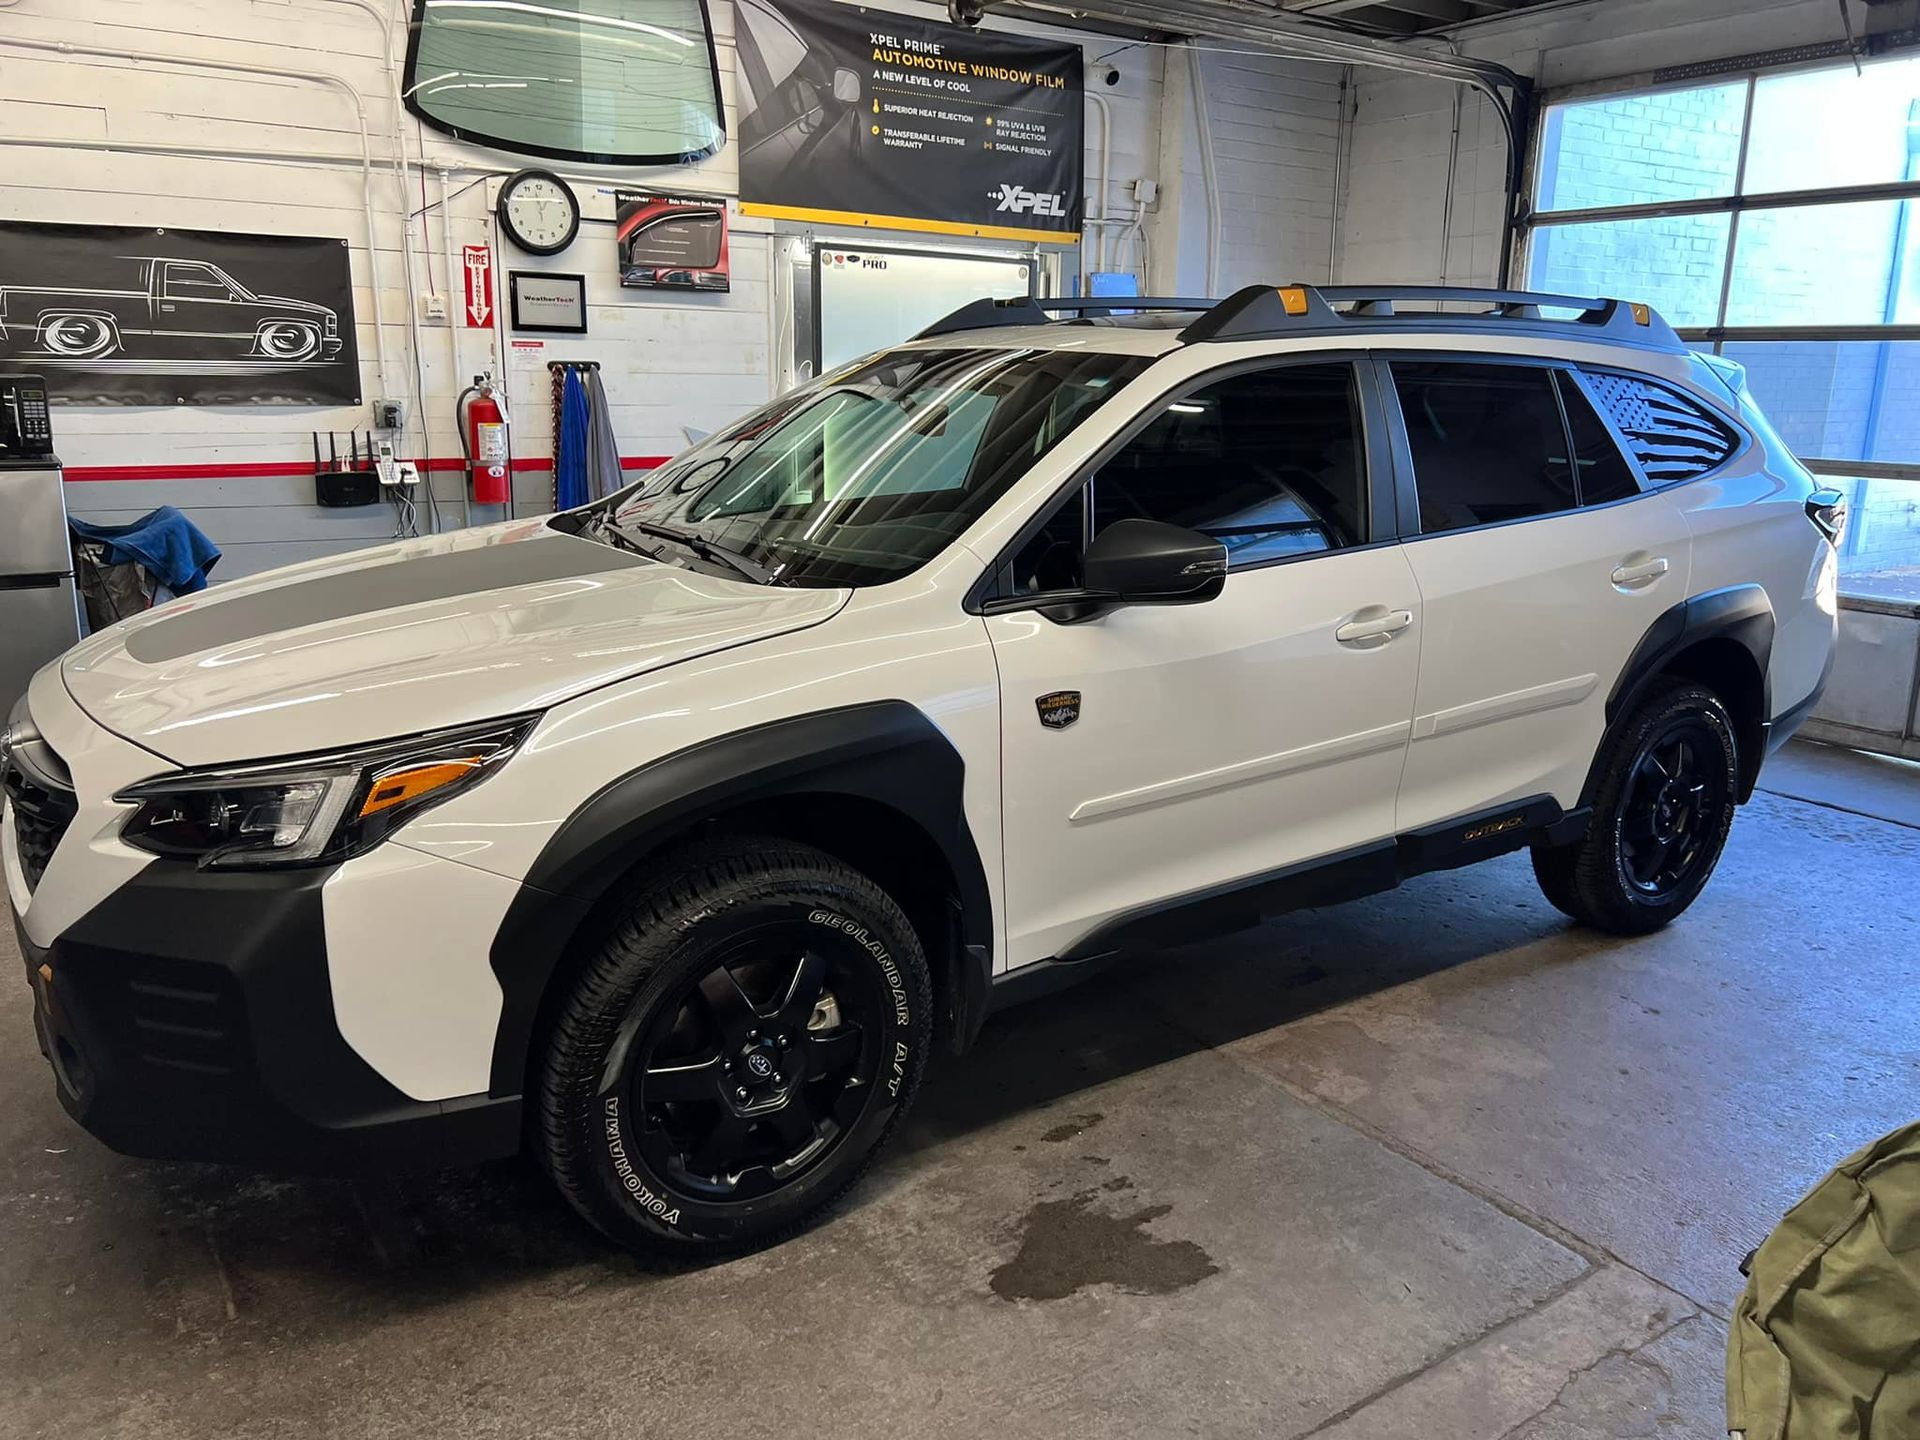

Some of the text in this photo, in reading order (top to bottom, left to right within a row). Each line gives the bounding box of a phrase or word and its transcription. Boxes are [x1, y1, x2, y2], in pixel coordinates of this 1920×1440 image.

[870, 33, 941, 55] XPEL PRIME
[873, 48, 1065, 89] AUTOMOTIVE WINDOW FILM
[873, 70, 971, 93] A NEW LEVEL OF COOL
[883, 104, 974, 123] SUPERIOR HEAT REJECTION
[996, 119, 1010, 128] 99%
[1031, 125, 1046, 133] UVB
[996, 128, 1047, 142] RAY REJECTION
[883, 128, 966, 146] TRANSFERABLE LIFETIME
[883, 138, 923, 150] WARRANTY
[995, 143, 1052, 157] SIGNAL FRIENDLY
[996, 183, 1066, 217] XPEL
[467, 253, 487, 265] FIRE
[863, 259, 888, 270] PRO
[808, 909, 909, 1027] GEOLANDAR
[887, 1041, 909, 1097] A/T
[605, 1096, 680, 1225] YOKOHAMA
